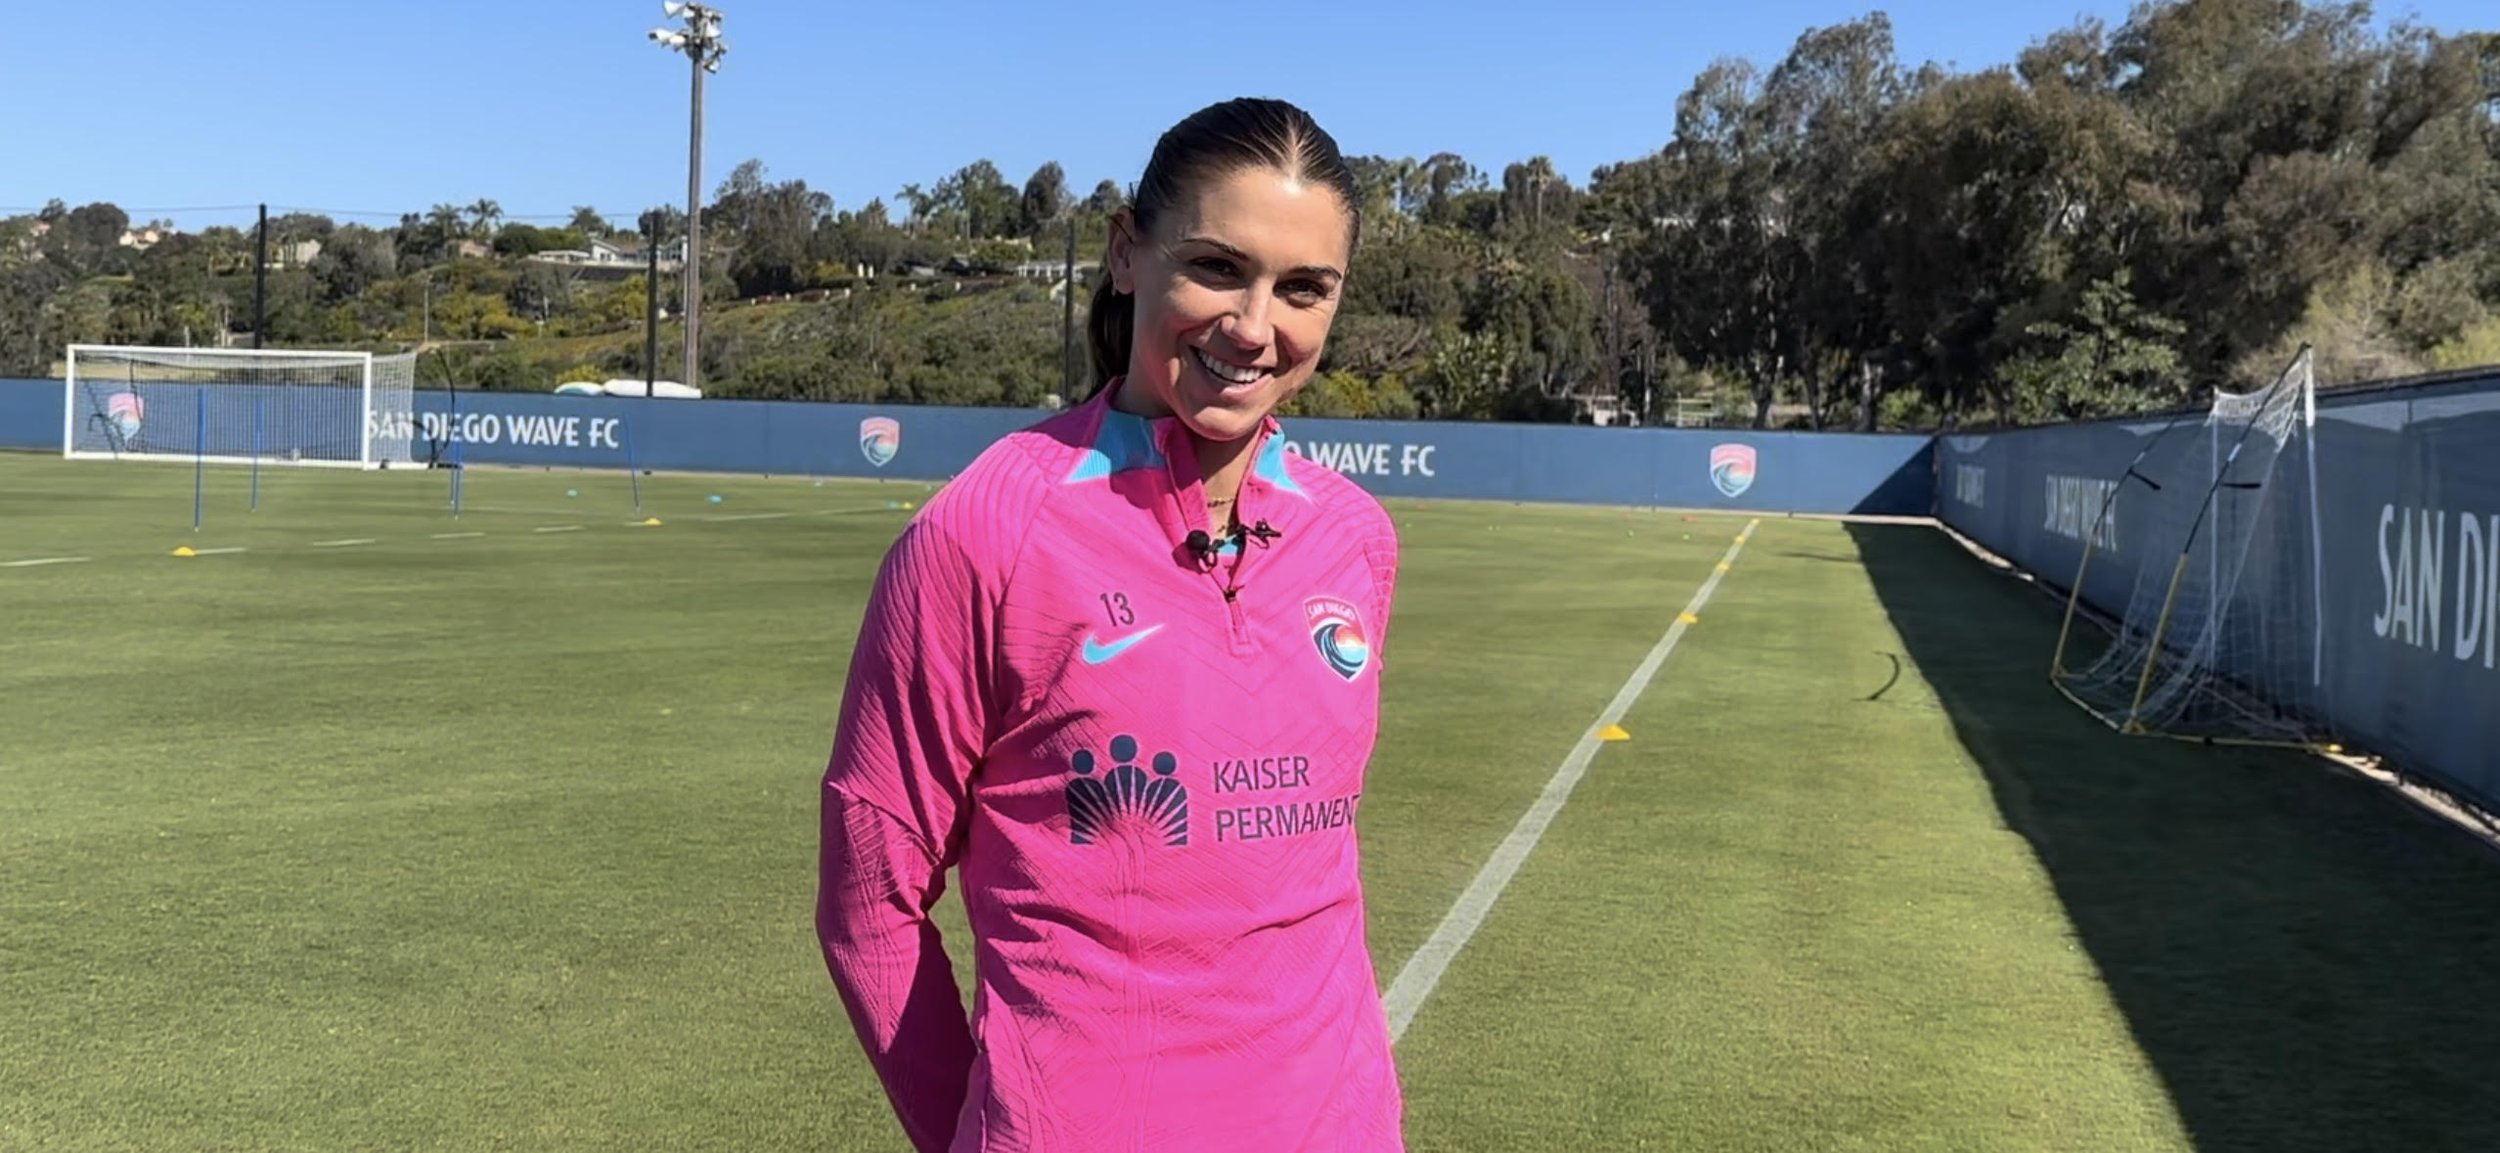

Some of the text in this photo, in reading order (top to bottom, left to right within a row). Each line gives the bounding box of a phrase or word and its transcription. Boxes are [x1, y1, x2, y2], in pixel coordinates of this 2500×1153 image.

[368, 411, 619, 448] SAN DIEGO WAVE FC
[1308, 441, 1391, 476] WAVE
[1401, 444, 1436, 477] FC
[2374, 503, 2500, 669] SAN DI
[1100, 592, 1135, 627] 13
[1213, 756, 1311, 794] KAISER
